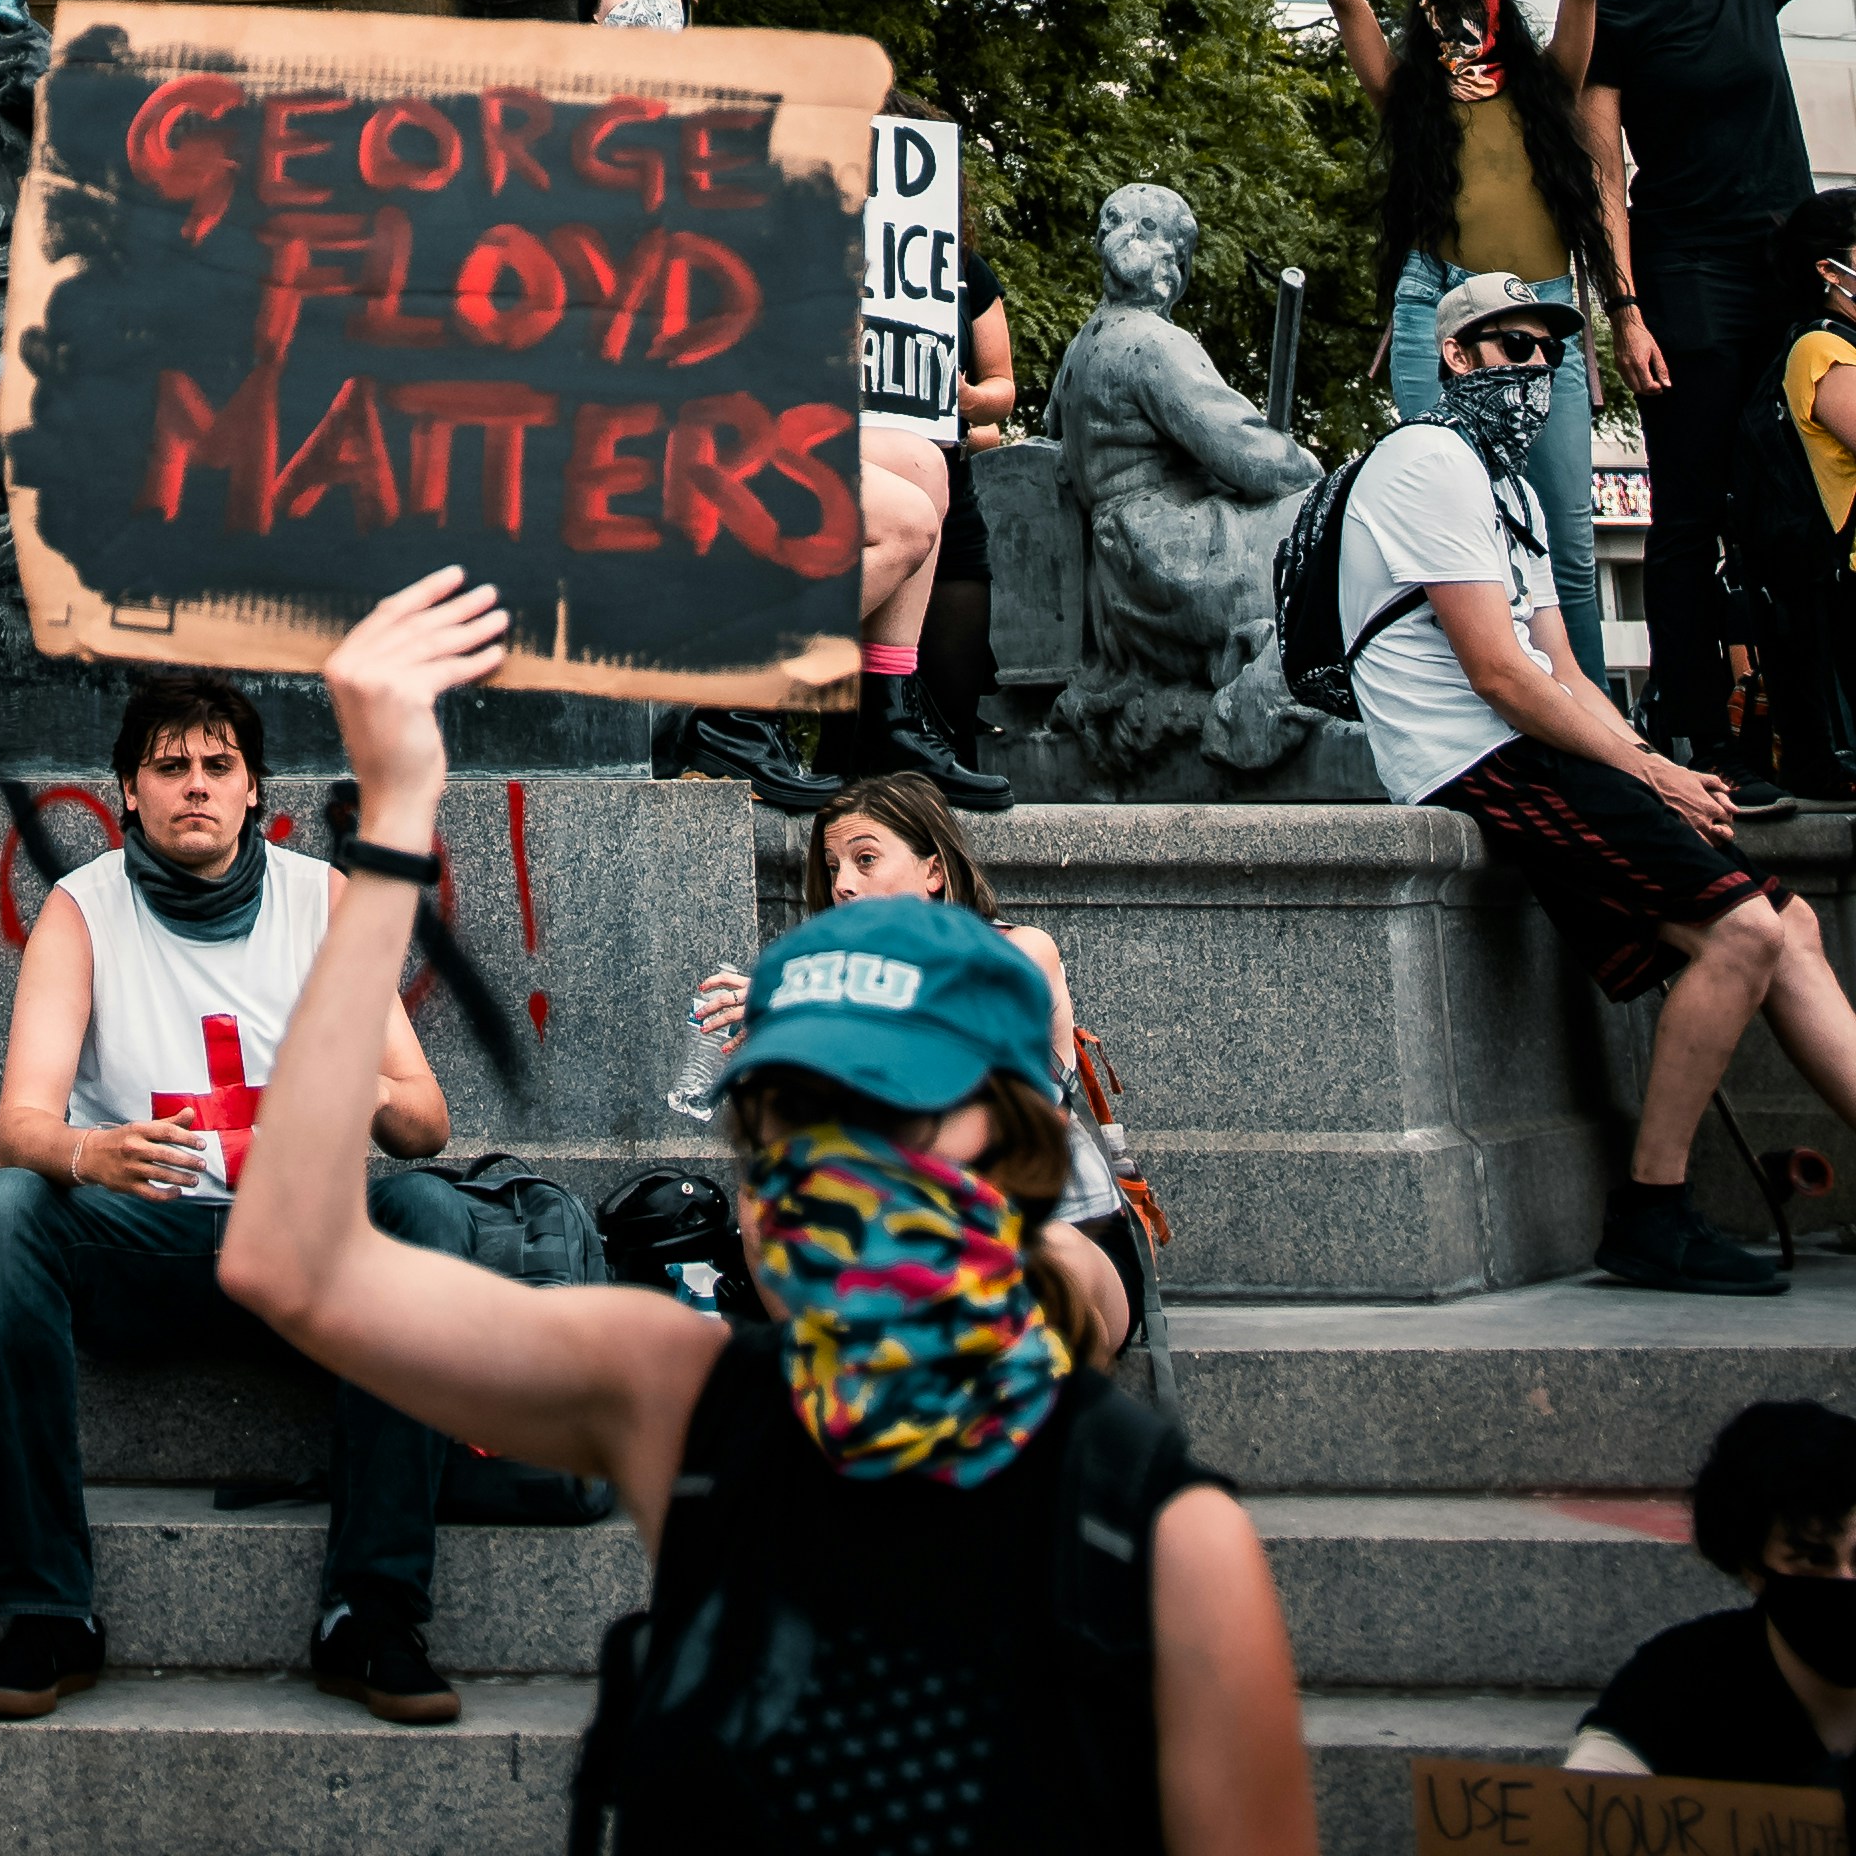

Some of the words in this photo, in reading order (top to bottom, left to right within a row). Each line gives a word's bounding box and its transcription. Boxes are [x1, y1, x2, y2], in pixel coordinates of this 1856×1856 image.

[126, 71, 770, 245] GEORGE
[256, 205, 766, 368] FLOYD
[144, 365, 860, 579] MATTERS
[1426, 1773, 1534, 1847] USE
[1563, 1783, 1715, 1856] YOUR
